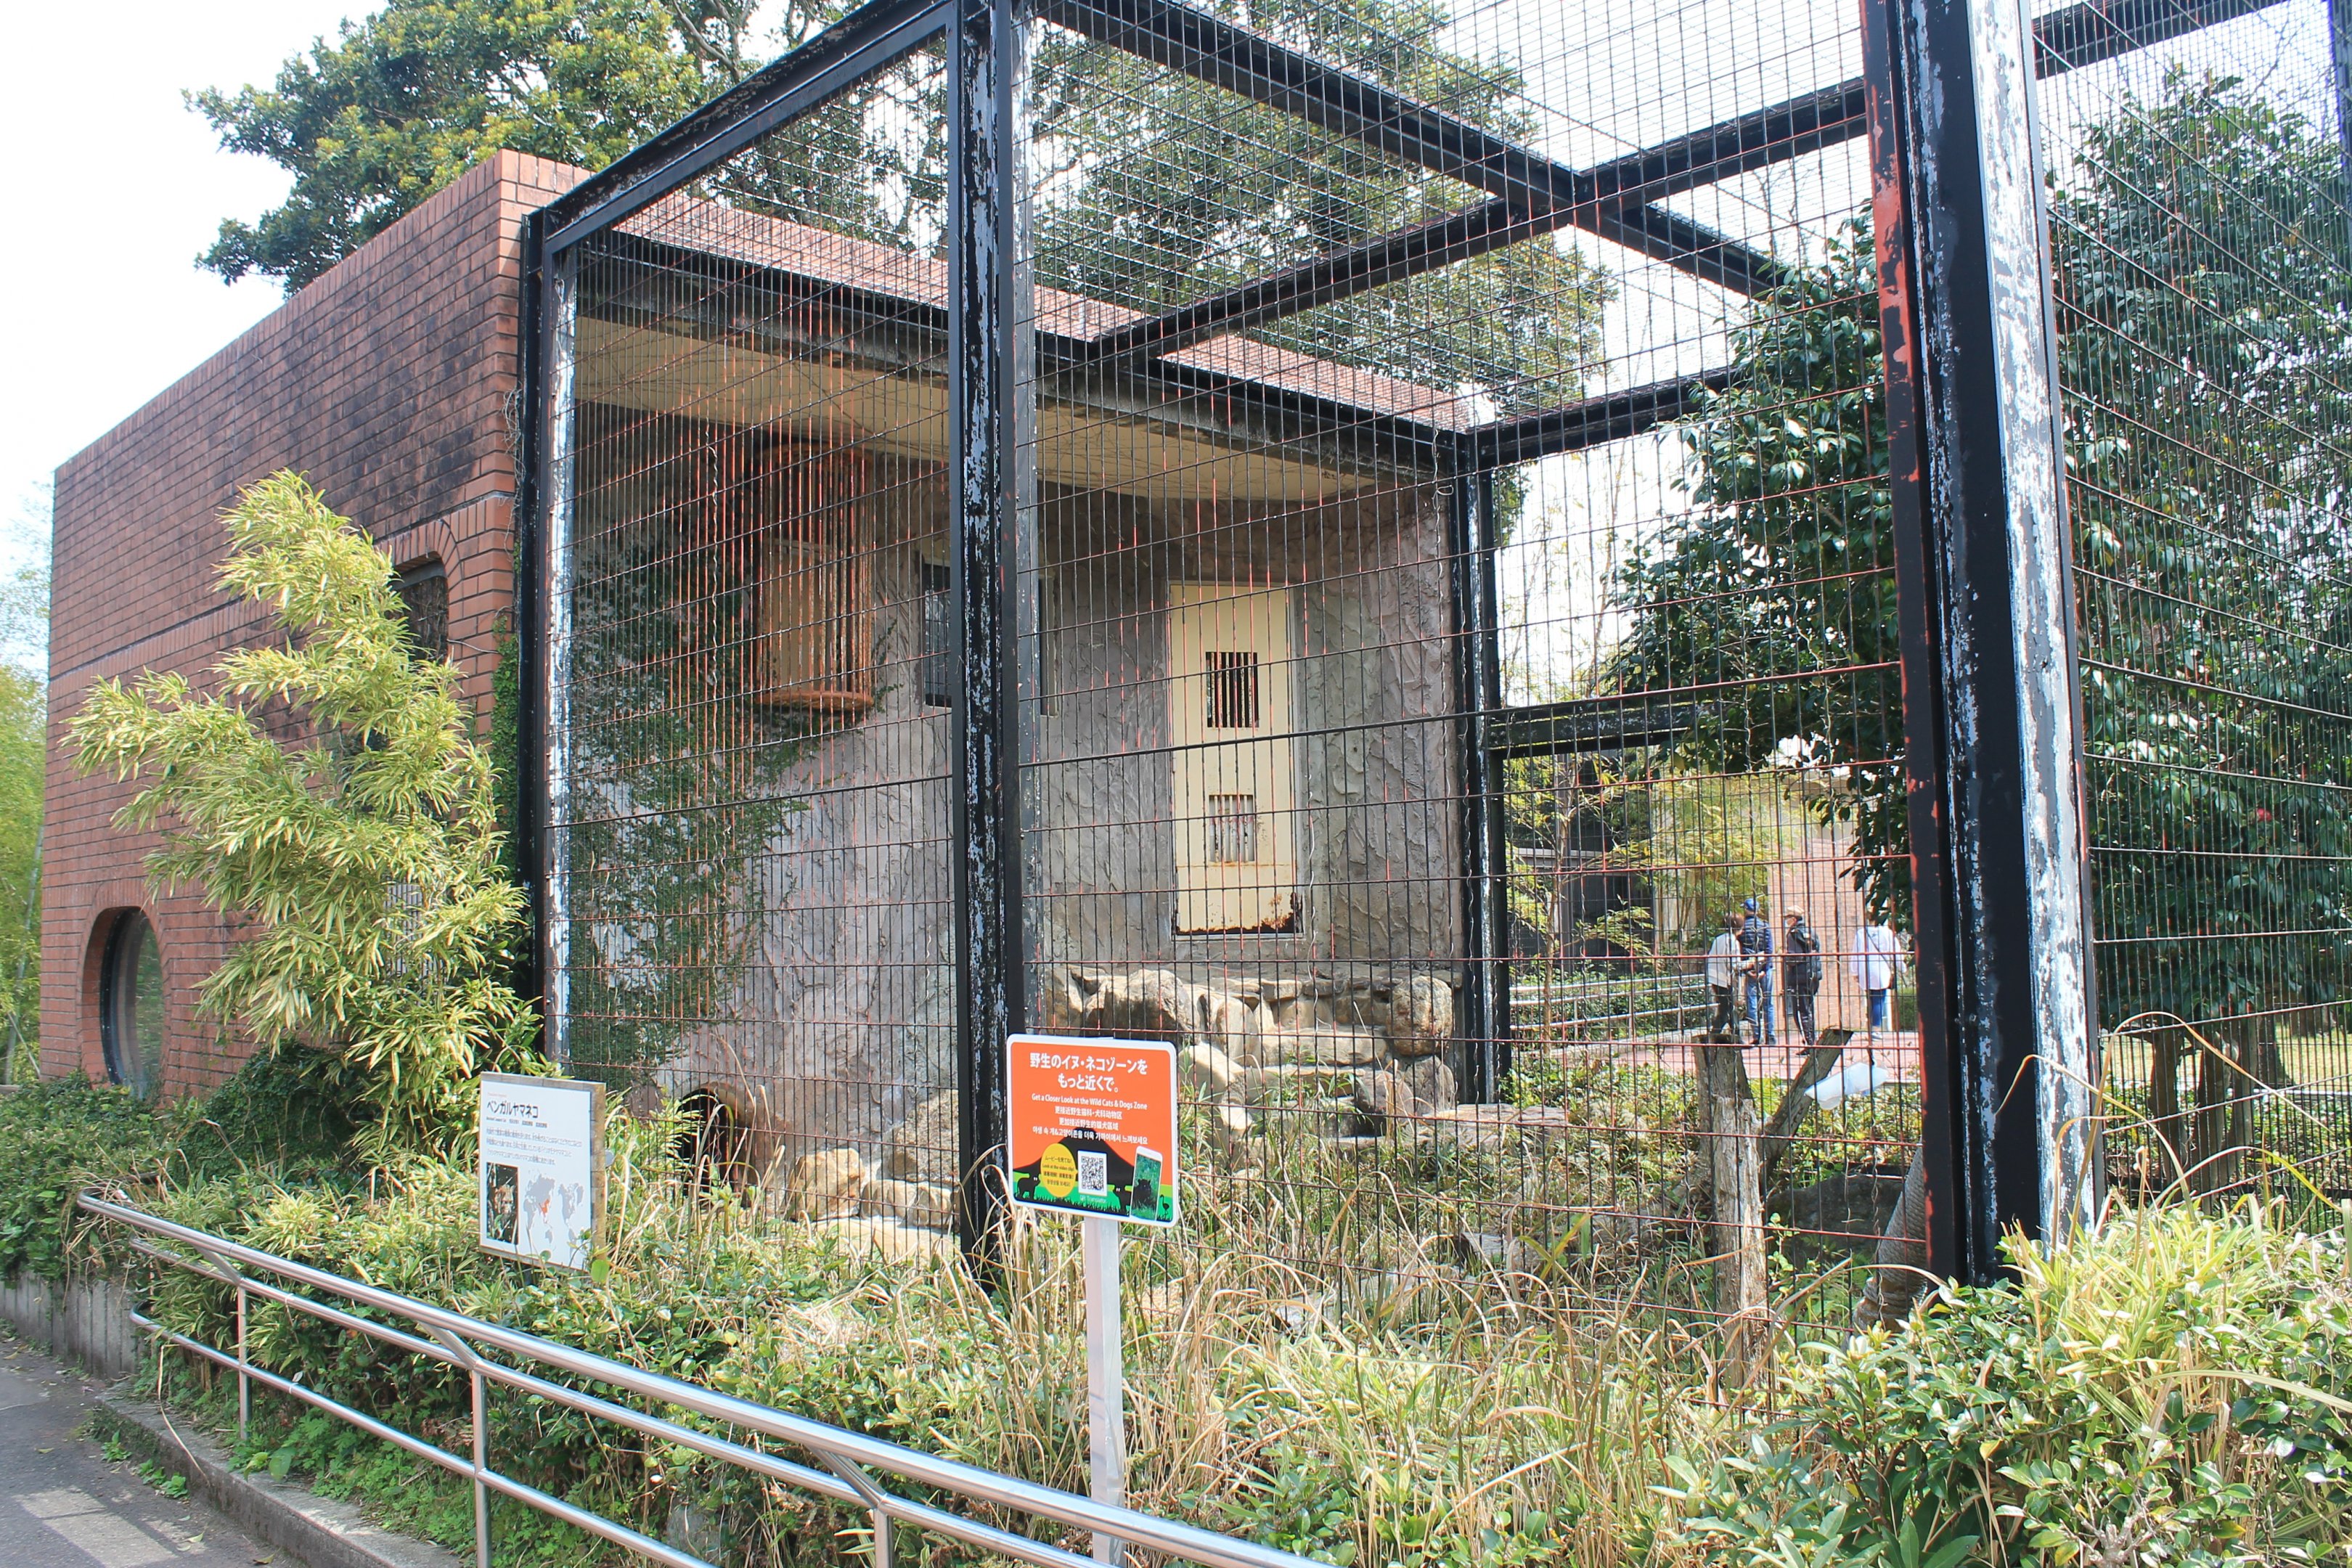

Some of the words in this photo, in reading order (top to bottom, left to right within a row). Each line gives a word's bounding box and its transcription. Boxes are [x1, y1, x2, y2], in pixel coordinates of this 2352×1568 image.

[1029, 1052, 1148, 1075] 野生のイヌ・ネコゾーンを
[1058, 1073, 1119, 1093] もっと近くで。
[487, 1100, 539, 1118] ベンガルヤマネコ
[1045, 1094, 1061, 1103] Closer
[1089, 1098, 1101, 1106] Wild
[1102, 1099, 1114, 1108] Cats
[1119, 1101, 1133, 1110] Dogs
[1134, 1101, 1148, 1110] Zone
